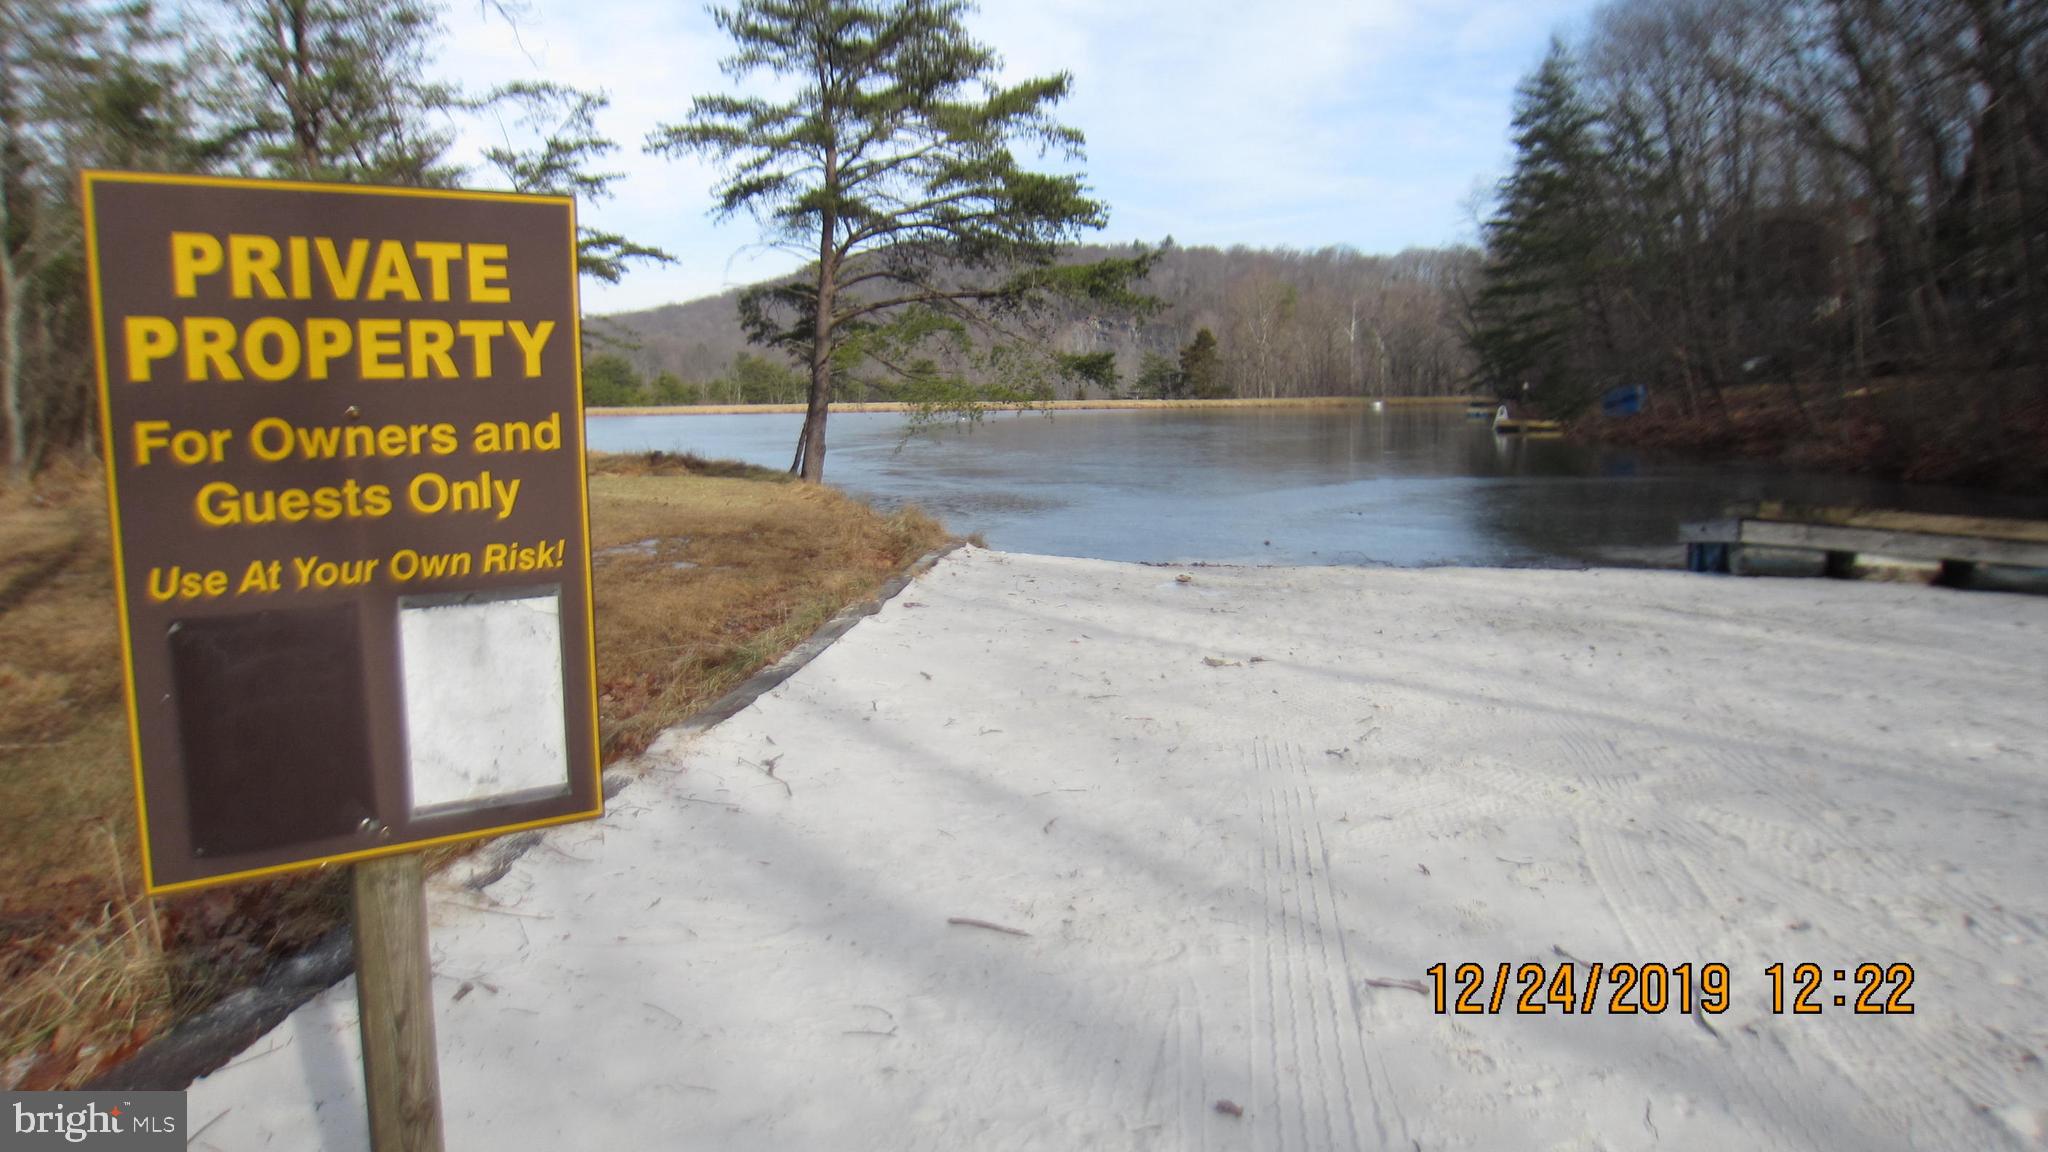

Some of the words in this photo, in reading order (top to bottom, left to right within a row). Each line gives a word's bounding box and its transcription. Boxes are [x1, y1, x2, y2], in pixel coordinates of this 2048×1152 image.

[171, 231, 511, 303] PRIVATE
[124, 315, 555, 383] PROPERTY
[134, 420, 232, 466] For
[251, 418, 458, 461] Owners
[474, 412, 562, 452] and
[197, 479, 392, 526] Guests
[409, 472, 520, 519] Only
[148, 566, 228, 600] Use
[238, 561, 281, 593] At
[294, 556, 378, 590] Your
[390, 548, 471, 580] Own
[484, 540, 565, 573] Risk!
